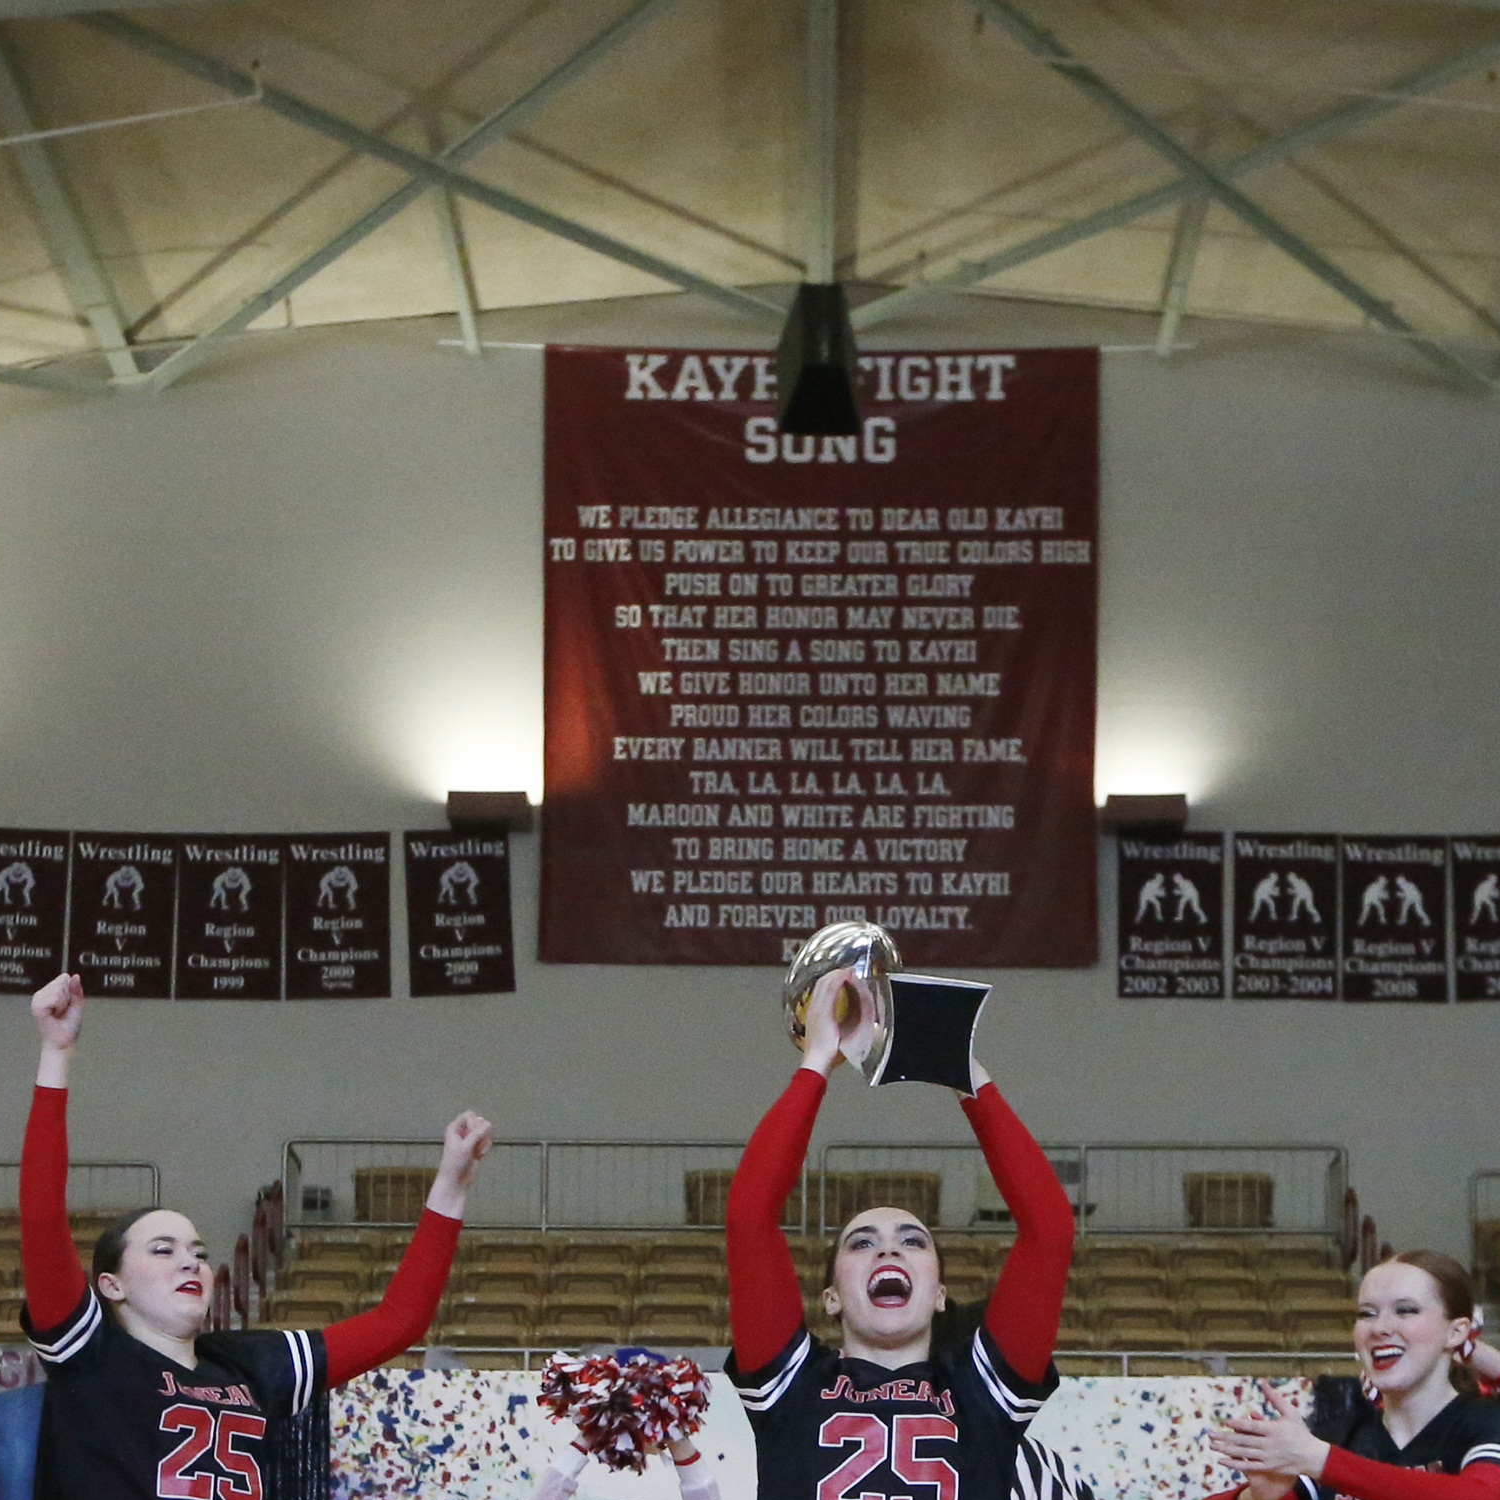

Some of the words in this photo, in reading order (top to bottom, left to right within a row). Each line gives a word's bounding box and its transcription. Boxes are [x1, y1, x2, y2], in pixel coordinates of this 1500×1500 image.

[624, 354, 779, 401] KAYH
[857, 354, 1017, 401] IGHT
[576, 503, 613, 530] WE
[618, 505, 700, 531] PLEDGE
[705, 506, 840, 532] ALLEGIANCE
[845, 507, 875, 532] TO
[880, 507, 941, 532] DEAR
[946, 507, 989, 532] OLD
[994, 506, 1064, 532] KAYHI
[548, 536, 577, 563] TO
[582, 537, 633, 563] GIVE
[638, 538, 667, 563] US
[671, 538, 746, 564] POWER
[750, 539, 779, 564] TO
[785, 540, 842, 565] KEEP
[846, 540, 889, 565] OUR
[893, 540, 951, 565] TRUE
[956, 539, 1034, 565] COLORS
[1040, 539, 1091, 564] HIGH
[663, 571, 722, 597] PUSH
[728, 572, 760, 598] ON
[764, 572, 794, 597] TO
[800, 573, 900, 598] GREATER
[905, 573, 975, 598] GLORY
[614, 603, 643, 629] SO
[647, 603, 709, 630] THAT
[712, 604, 758, 630] HER
[765, 605, 839, 630] HONOR
[846, 605, 895, 630] MAY
[901, 605, 975, 631] NEVER
[660, 636, 721, 663] THEN
[727, 637, 780, 663] SING
[785, 639, 804, 663] A
[809, 638, 866, 664] SONG
[871, 638, 902, 664] TO
[907, 639, 978, 663] KAYHI
[636, 670, 674, 696] WE
[679, 670, 731, 696] GIVE
[737, 671, 812, 696] HONOR
[818, 672, 877, 697] UNTO
[884, 672, 929, 697] HER
[935, 672, 1002, 698] NAME
[669, 702, 741, 728] PROUD
[747, 703, 792, 729] HER
[799, 704, 879, 729] COLORS
[885, 704, 972, 729] WAVING
[611, 735, 686, 762] EVERY
[691, 736, 783, 762] BANNER
[788, 737, 844, 763] WILL
[848, 738, 904, 763] TELL
[909, 737, 955, 763] HER
[626, 802, 721, 828] MAROON
[726, 803, 774, 828] AND
[780, 803, 855, 829] WHITE
[859, 804, 906, 829] ARE
[912, 804, 1016, 830] FIGHTING
[290, 843, 385, 863] Wrestling
[409, 840, 505, 859] Wrestling
[671, 836, 701, 861] TO
[707, 836, 775, 862] BRING
[781, 837, 846, 863] HOME
[850, 838, 869, 863] A
[874, 837, 968, 863] VICTORY
[1122, 840, 1221, 863] Wrestling
[1236, 839, 1336, 862] Wrestling
[629, 869, 666, 895] WE
[672, 869, 754, 895] PLEDGE
[760, 870, 805, 896] OUR
[810, 870, 899, 896] HEARTS
[904, 871, 934, 897] TO
[940, 871, 1011, 897] KAYHI
[313, 916, 362, 931] Region
[435, 913, 485, 927] Region
[663, 903, 711, 929] AND
[717, 903, 817, 929] FOREVER
[420, 944, 502, 959] Champions
[1130, 936, 1193, 952] Region
[1197, 935, 1212, 952] V
[1244, 934, 1306, 952] Region
[1312, 936, 1325, 951] V
[297, 948, 379, 963] Champions
[1120, 954, 1221, 972] Champions
[1234, 954, 1335, 971] Champions
[321, 965, 355, 978] 2000
[445, 962, 479, 976] 2000
[819, 1374, 957, 1418] JUNEAU
